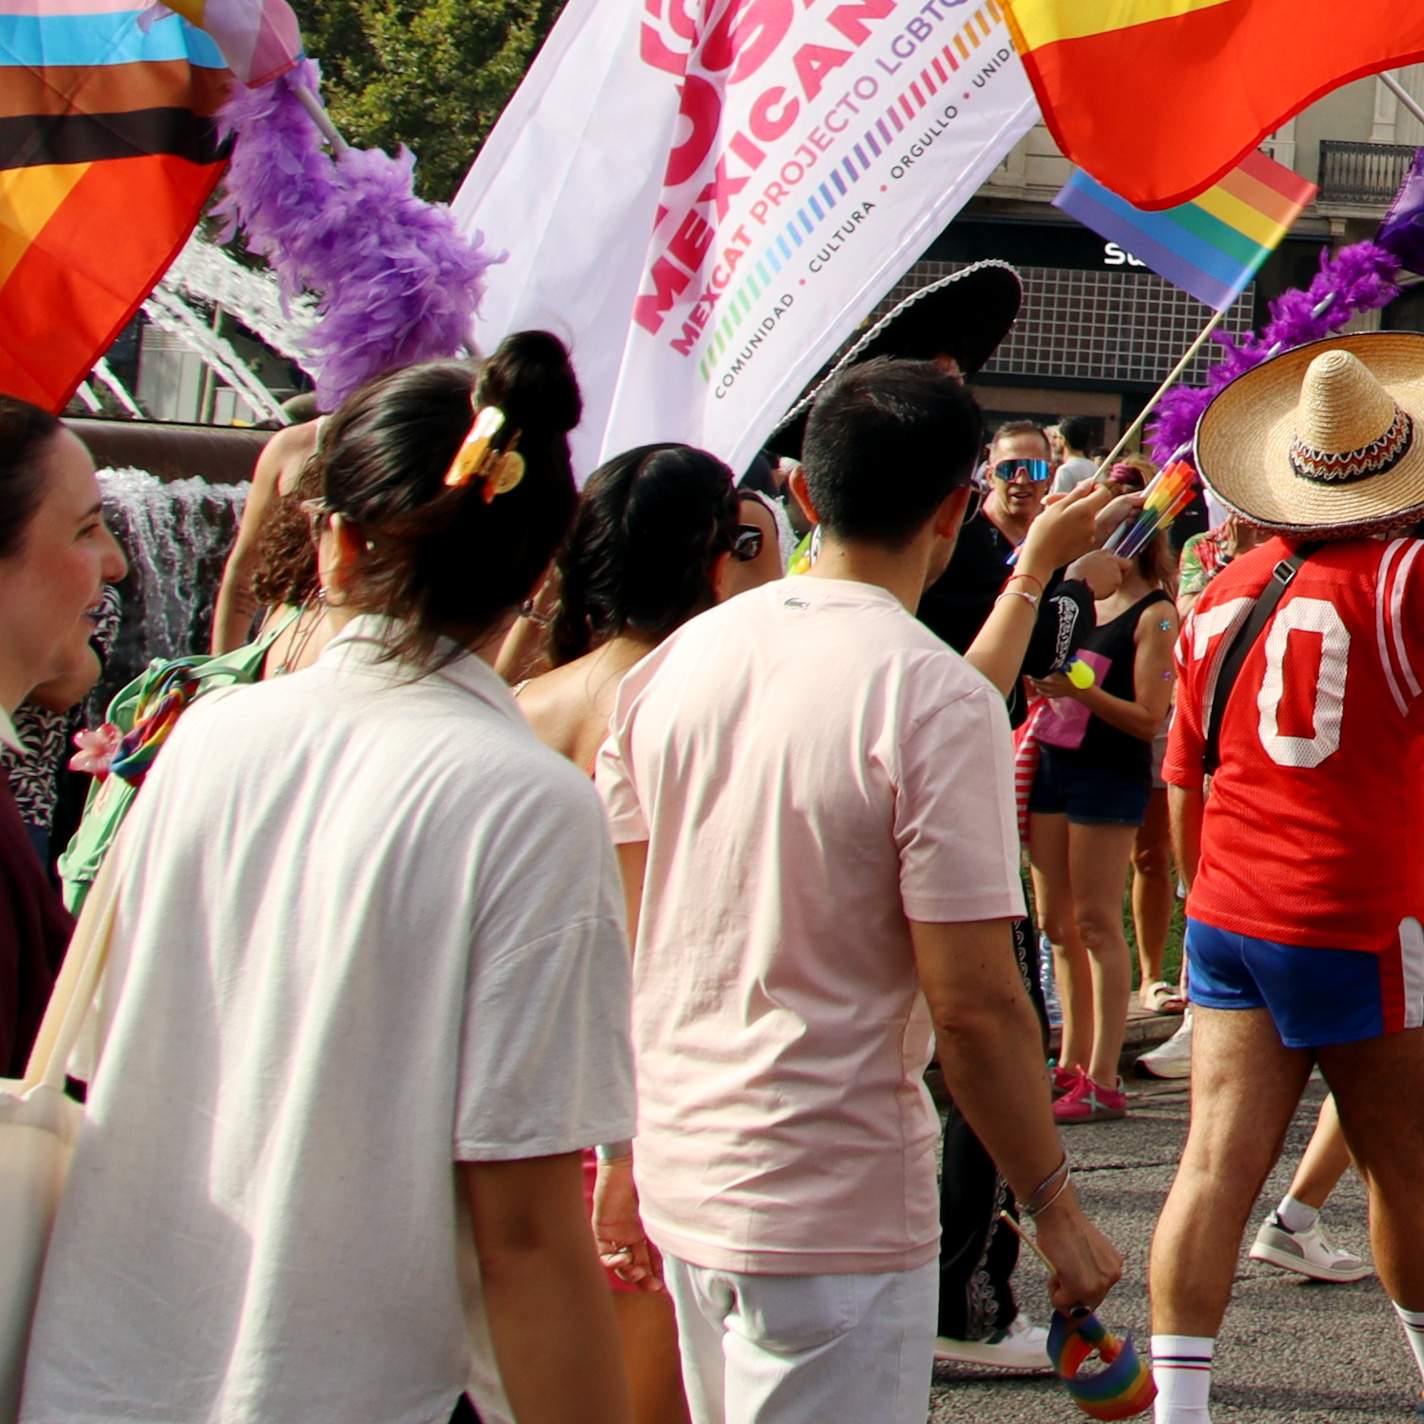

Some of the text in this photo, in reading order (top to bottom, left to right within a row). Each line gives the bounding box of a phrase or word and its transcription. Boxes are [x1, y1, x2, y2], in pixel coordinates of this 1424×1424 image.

[670, 224, 752, 357] MEXCAT
[750, 74, 878, 226] PROJECTO
[715, 293, 794, 399] COMUNIDAD
[808, 201, 877, 273] CULTURA
[890, 105, 959, 180] ORGULLO
[1192, 596, 1351, 769] 70
